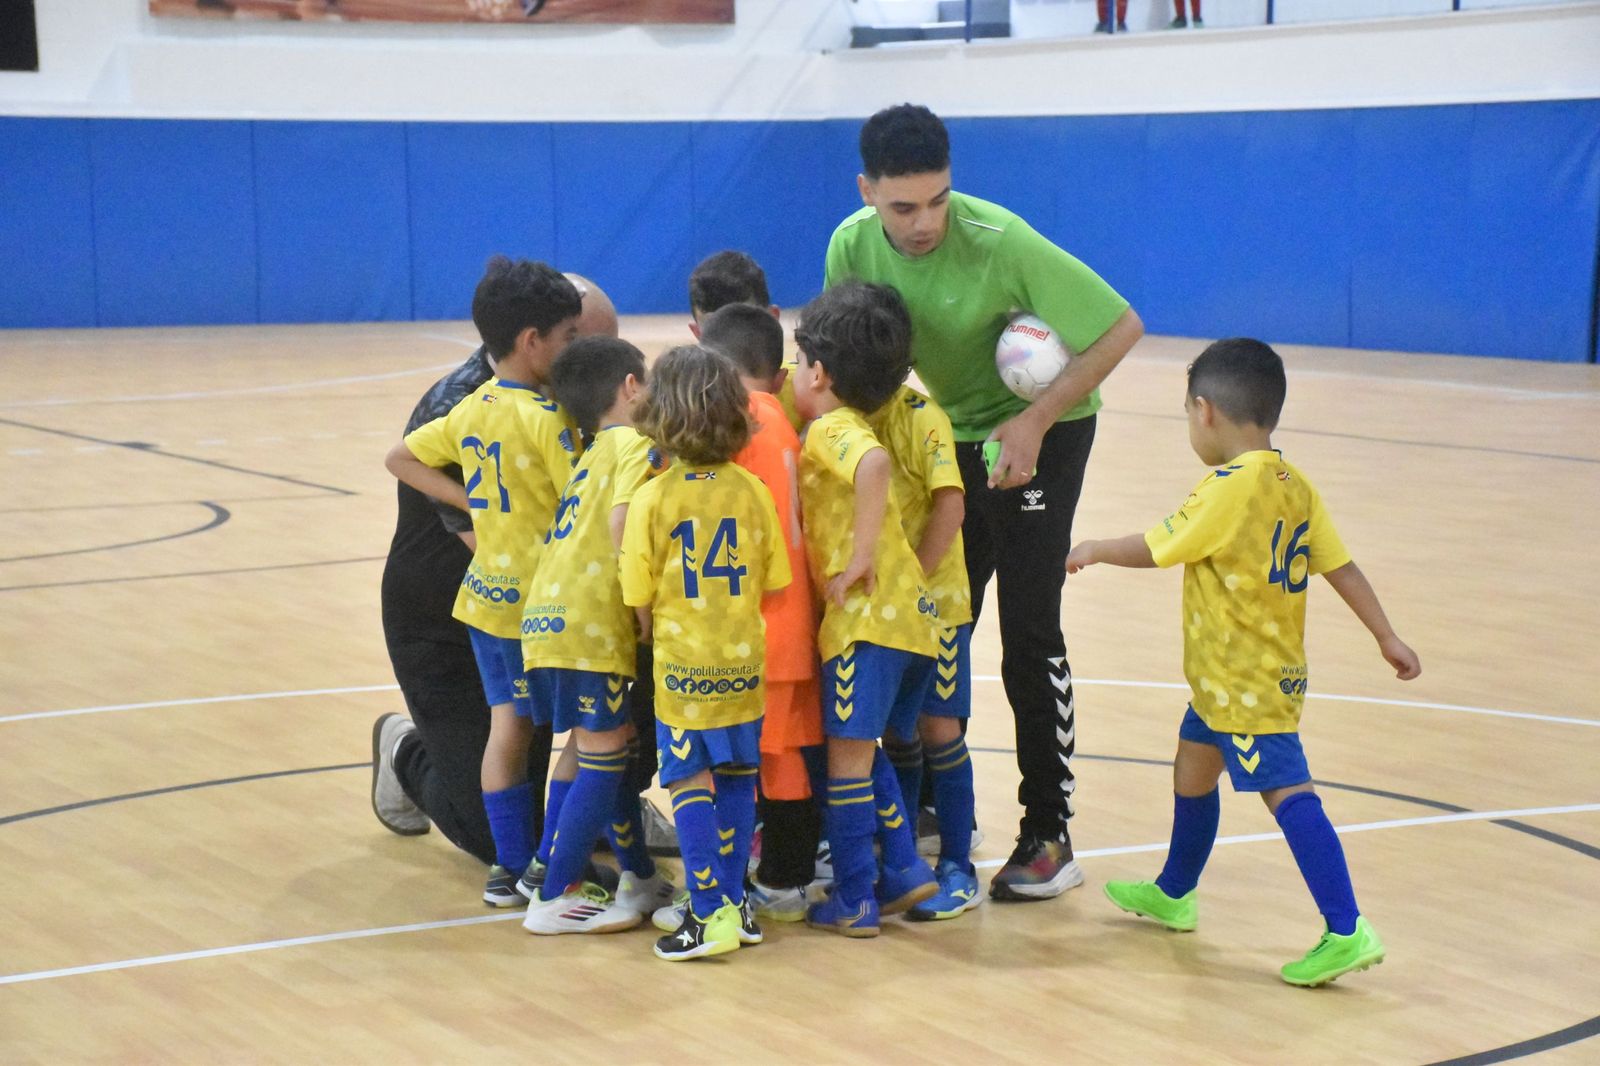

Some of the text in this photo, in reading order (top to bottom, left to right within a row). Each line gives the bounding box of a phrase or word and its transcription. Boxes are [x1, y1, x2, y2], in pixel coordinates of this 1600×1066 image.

[461, 435, 511, 513] 21
[670, 517, 747, 599] 14
[1268, 519, 1311, 594] 46
